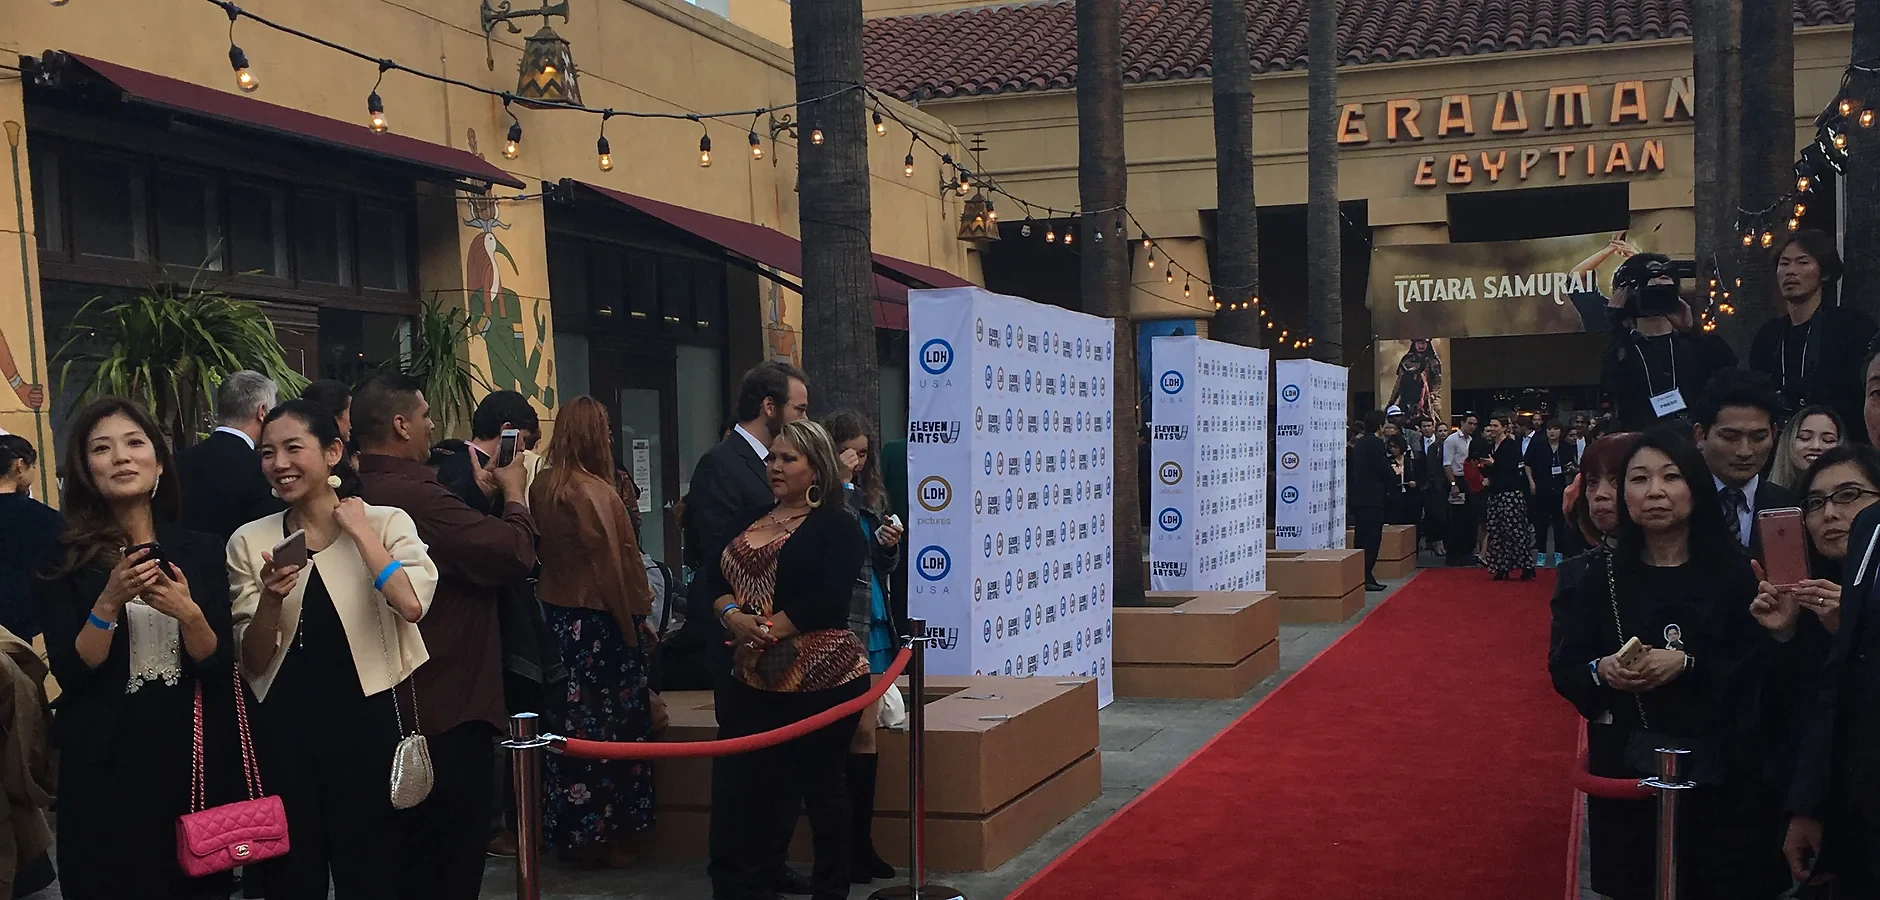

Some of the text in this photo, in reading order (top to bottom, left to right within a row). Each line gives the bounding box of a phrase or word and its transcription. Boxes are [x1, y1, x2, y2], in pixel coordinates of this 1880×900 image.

[1414, 140, 1665, 186] EGYPTIAN
[1395, 269, 1594, 313] TATARA SAMURAI
[926, 351, 947, 363] LDH
[1164, 378, 1180, 387] LDH
[910, 421, 947, 432] ELEVEN
[1154, 424, 1180, 433] ELEVEN
[909, 432, 939, 443] ARTS
[1163, 469, 1178, 478] LDH
[924, 488, 946, 500] LDH
[917, 517, 951, 526] pictures
[1163, 515, 1178, 524] LDH
[922, 557, 945, 569] LDH
